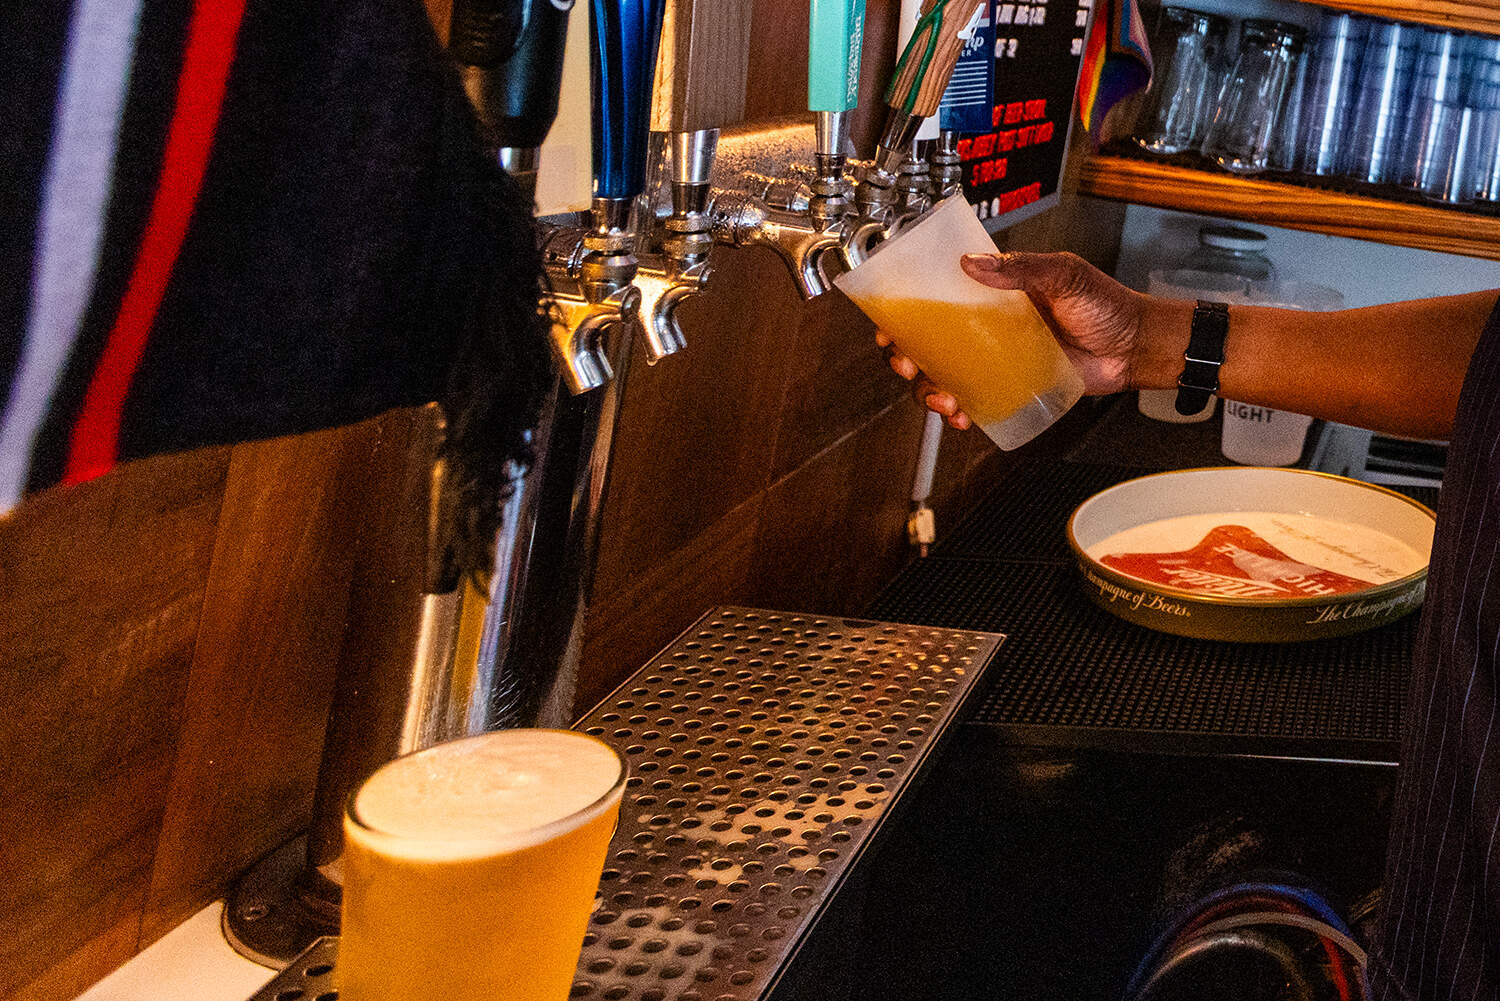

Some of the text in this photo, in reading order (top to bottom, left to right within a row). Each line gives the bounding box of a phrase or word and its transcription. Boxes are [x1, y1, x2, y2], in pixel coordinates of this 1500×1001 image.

[1227, 401, 1274, 423] LIGHT
[1129, 593, 1147, 611] of
[1305, 604, 1343, 624] The
